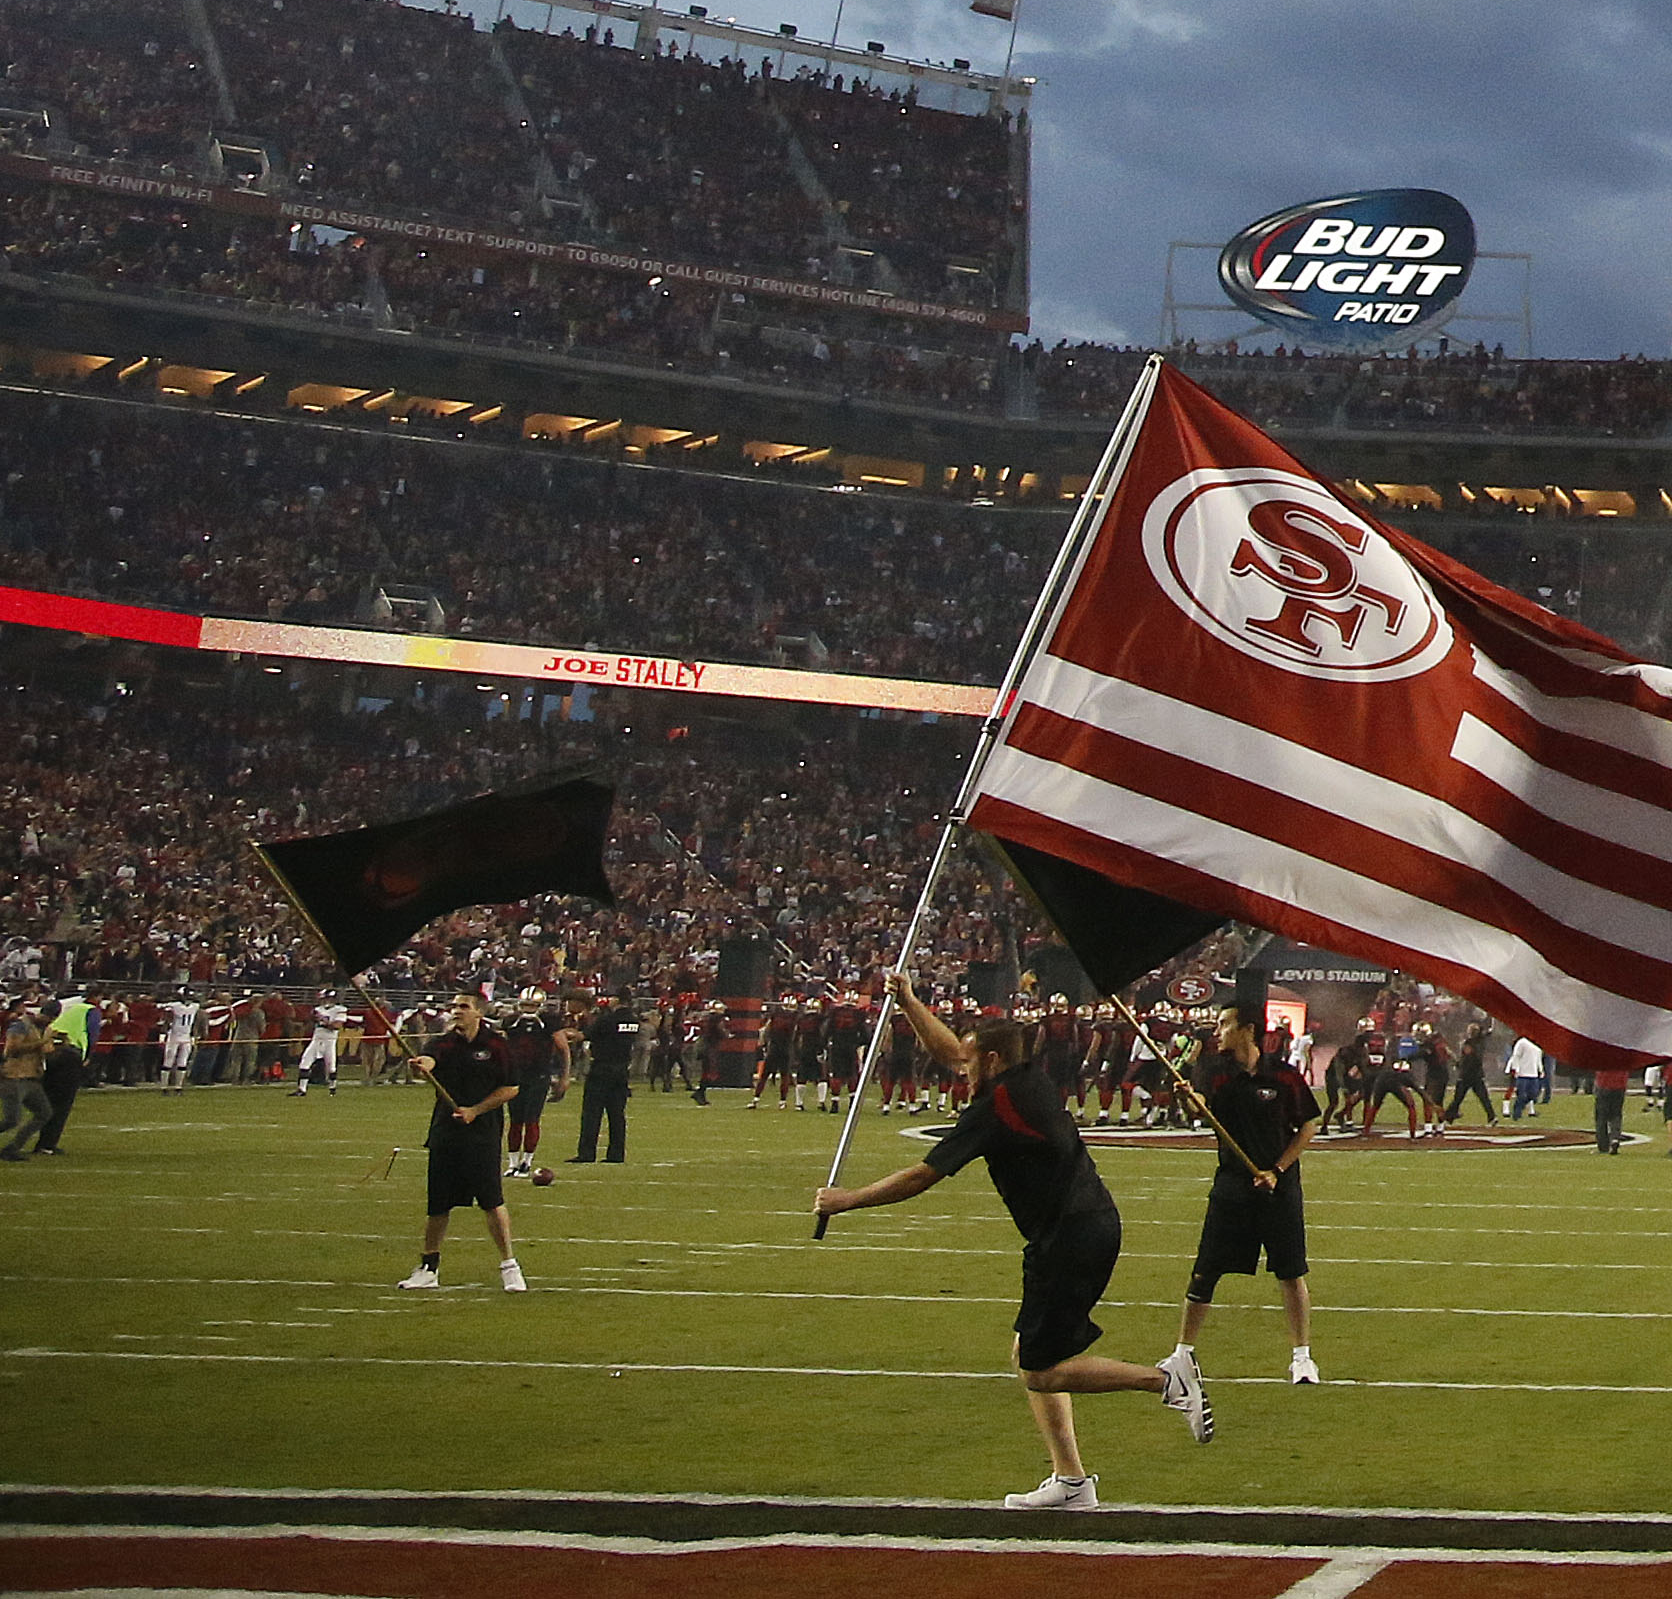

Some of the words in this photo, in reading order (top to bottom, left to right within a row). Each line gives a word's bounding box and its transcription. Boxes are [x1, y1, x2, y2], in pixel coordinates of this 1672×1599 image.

[49, 165, 95, 184] FREE
[97, 173, 167, 196] XFINITY
[170, 184, 213, 202] WI-FI
[280, 202, 324, 220] NEED
[327, 211, 432, 237] ASSISTANCE?
[437, 227, 476, 244] TEXT
[567, 248, 587, 261] TO
[641, 260, 663, 274] OR
[665, 263, 702, 280] CALL
[704, 269, 750, 287] GUEST
[752, 277, 818, 299] SERVICES
[821, 287, 881, 308] HOTLINE
[1293, 218, 1446, 258] BUD
[1254, 254, 1462, 296] LIGHT
[1333, 301, 1420, 323] PATIO
[543, 657, 608, 676] JOE
[616, 657, 706, 688] STALEY
[1327, 970, 1387, 983] STADIUM
